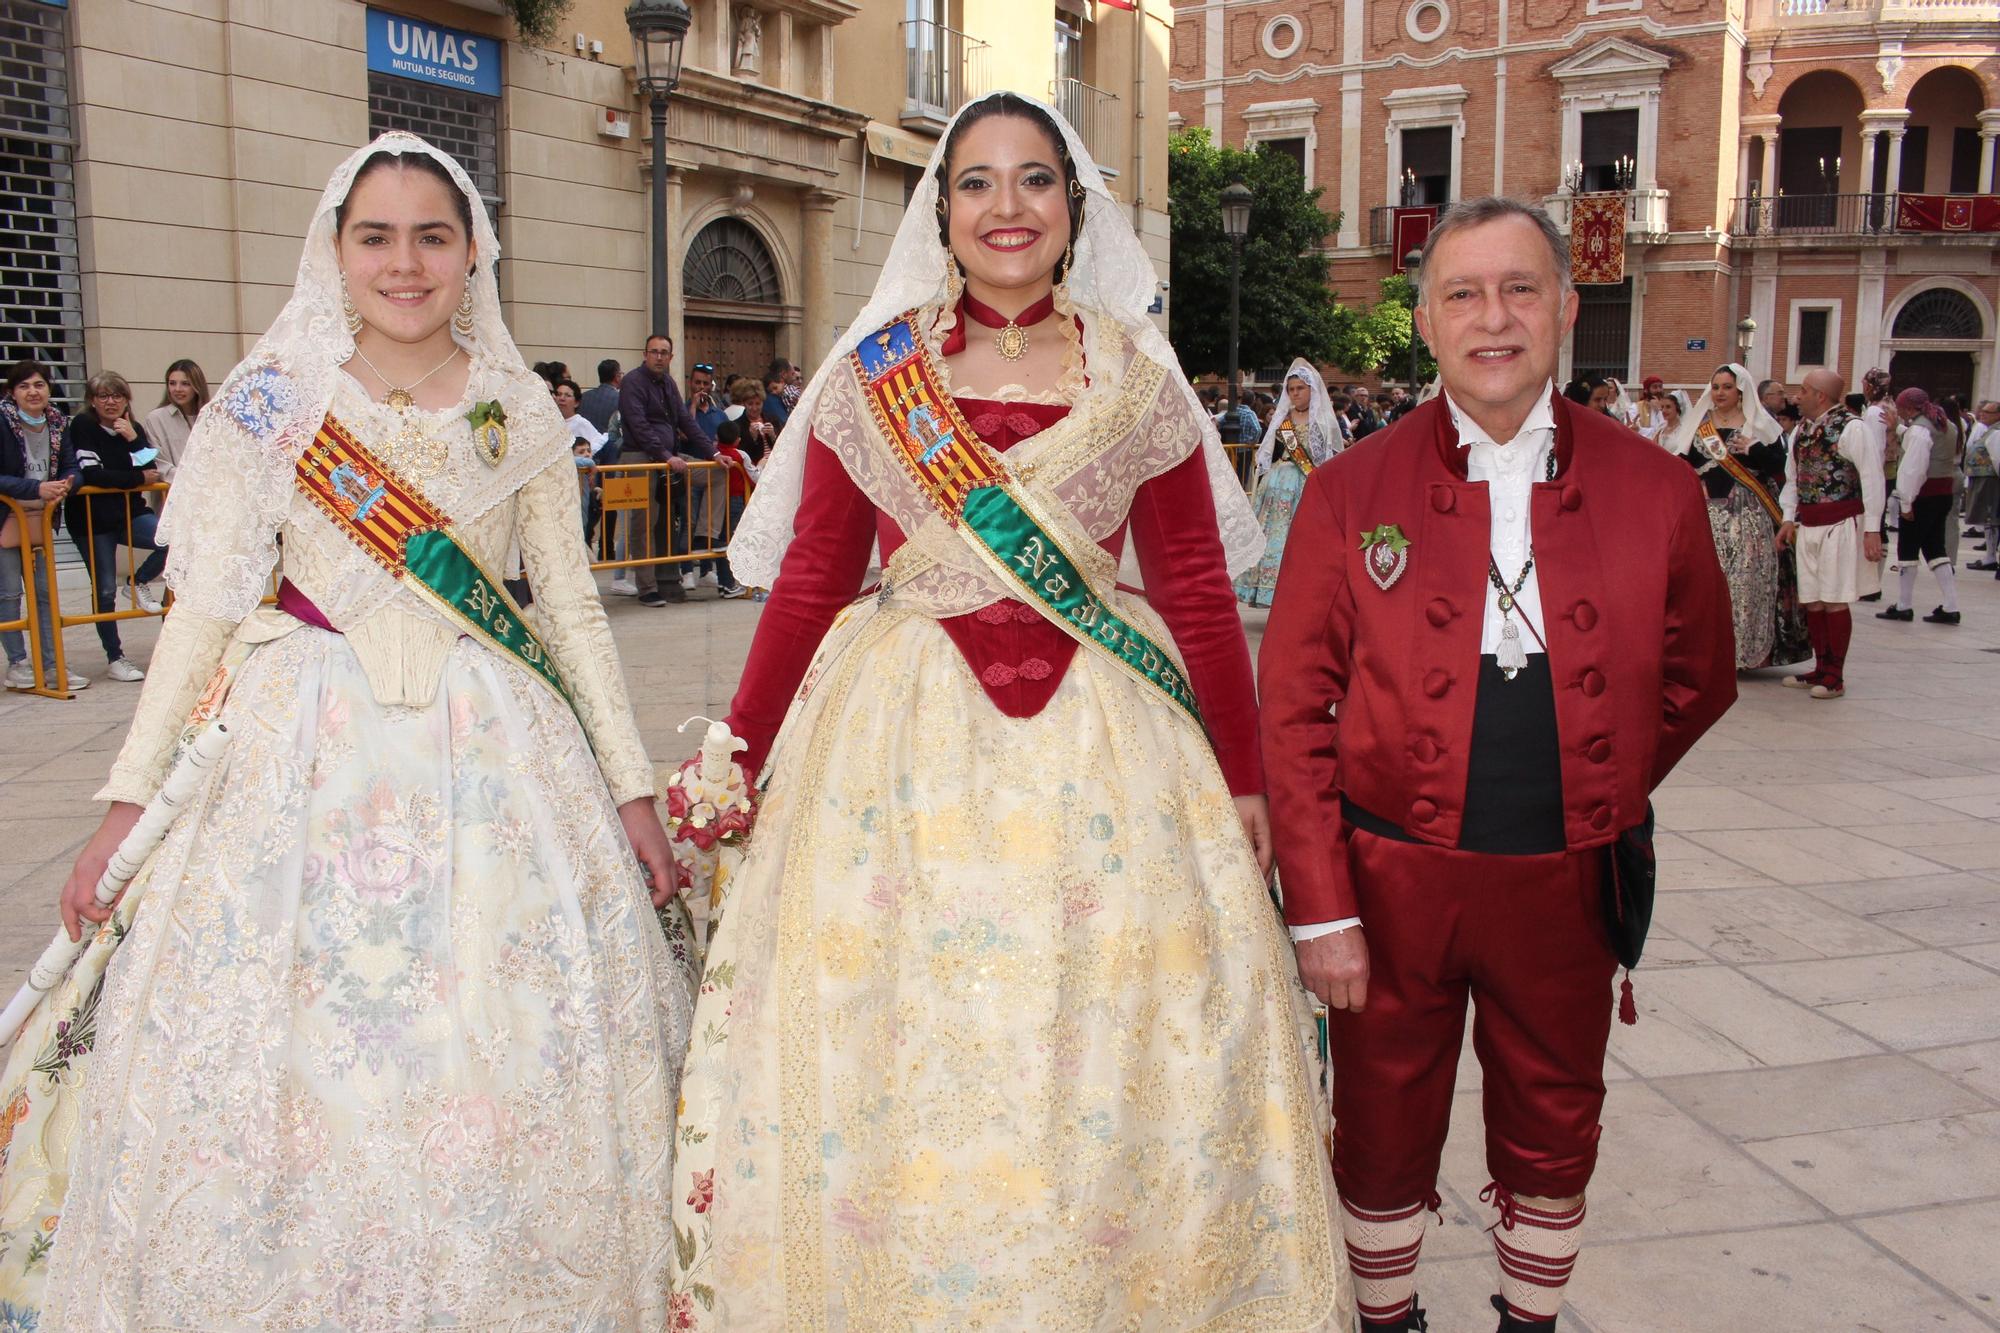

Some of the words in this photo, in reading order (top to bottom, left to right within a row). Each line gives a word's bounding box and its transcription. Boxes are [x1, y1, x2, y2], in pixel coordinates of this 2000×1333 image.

[388, 20, 478, 71] UMAS
[393, 59, 424, 74] MUTUA
[425, 66, 436, 77] DE
[438, 69, 475, 85] SEGUROS
[1014, 536, 1070, 601] Na
[464, 579, 512, 638] Na
